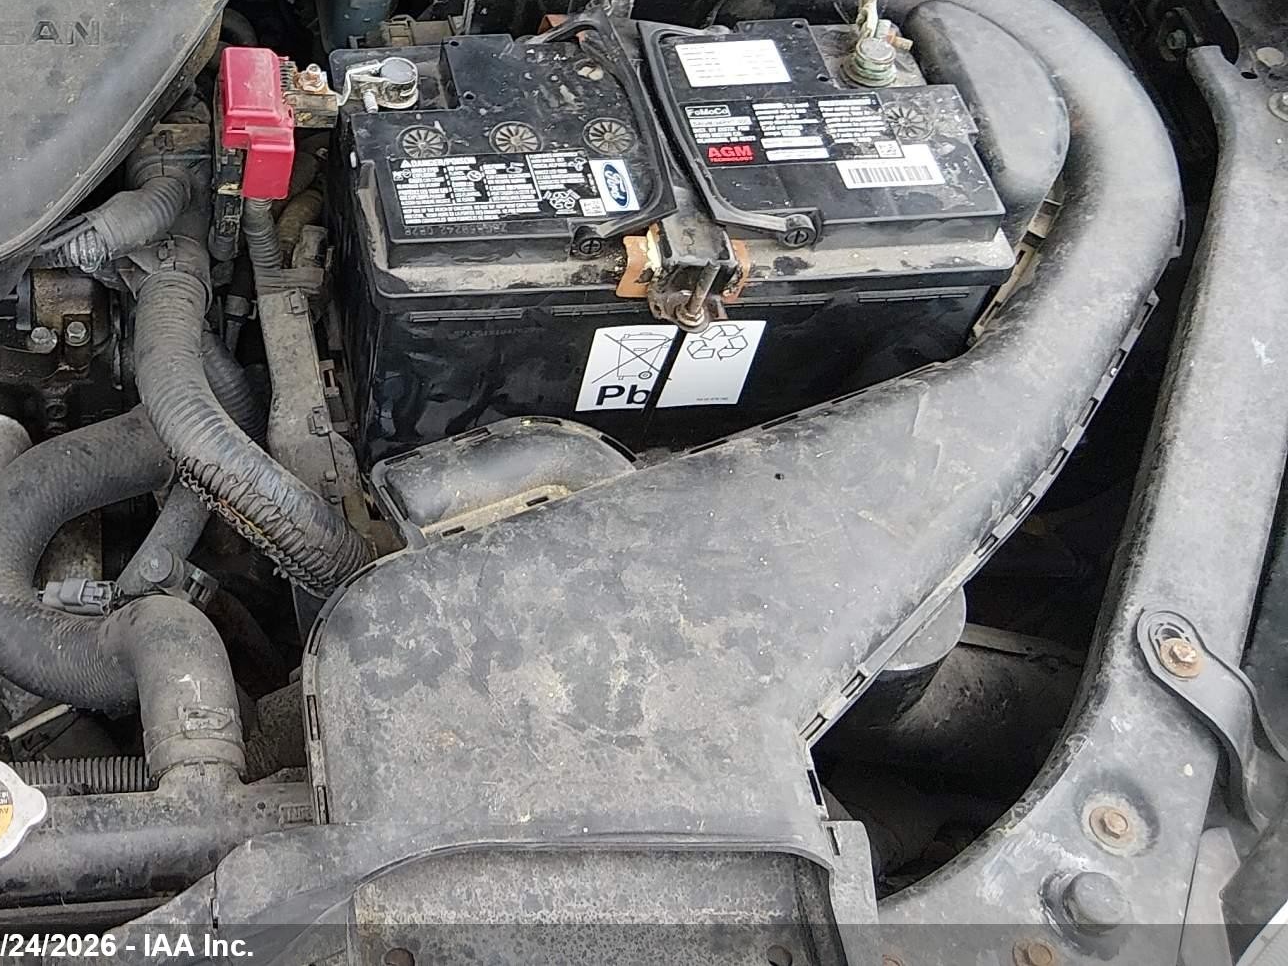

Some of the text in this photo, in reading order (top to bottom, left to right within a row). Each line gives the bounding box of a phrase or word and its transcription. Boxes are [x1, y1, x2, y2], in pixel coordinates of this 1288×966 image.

[688, 107, 729, 117] FoMoCo
[708, 145, 753, 158] AGM
[605, 168, 626, 202] Ford
[595, 384, 652, 406] Pb
